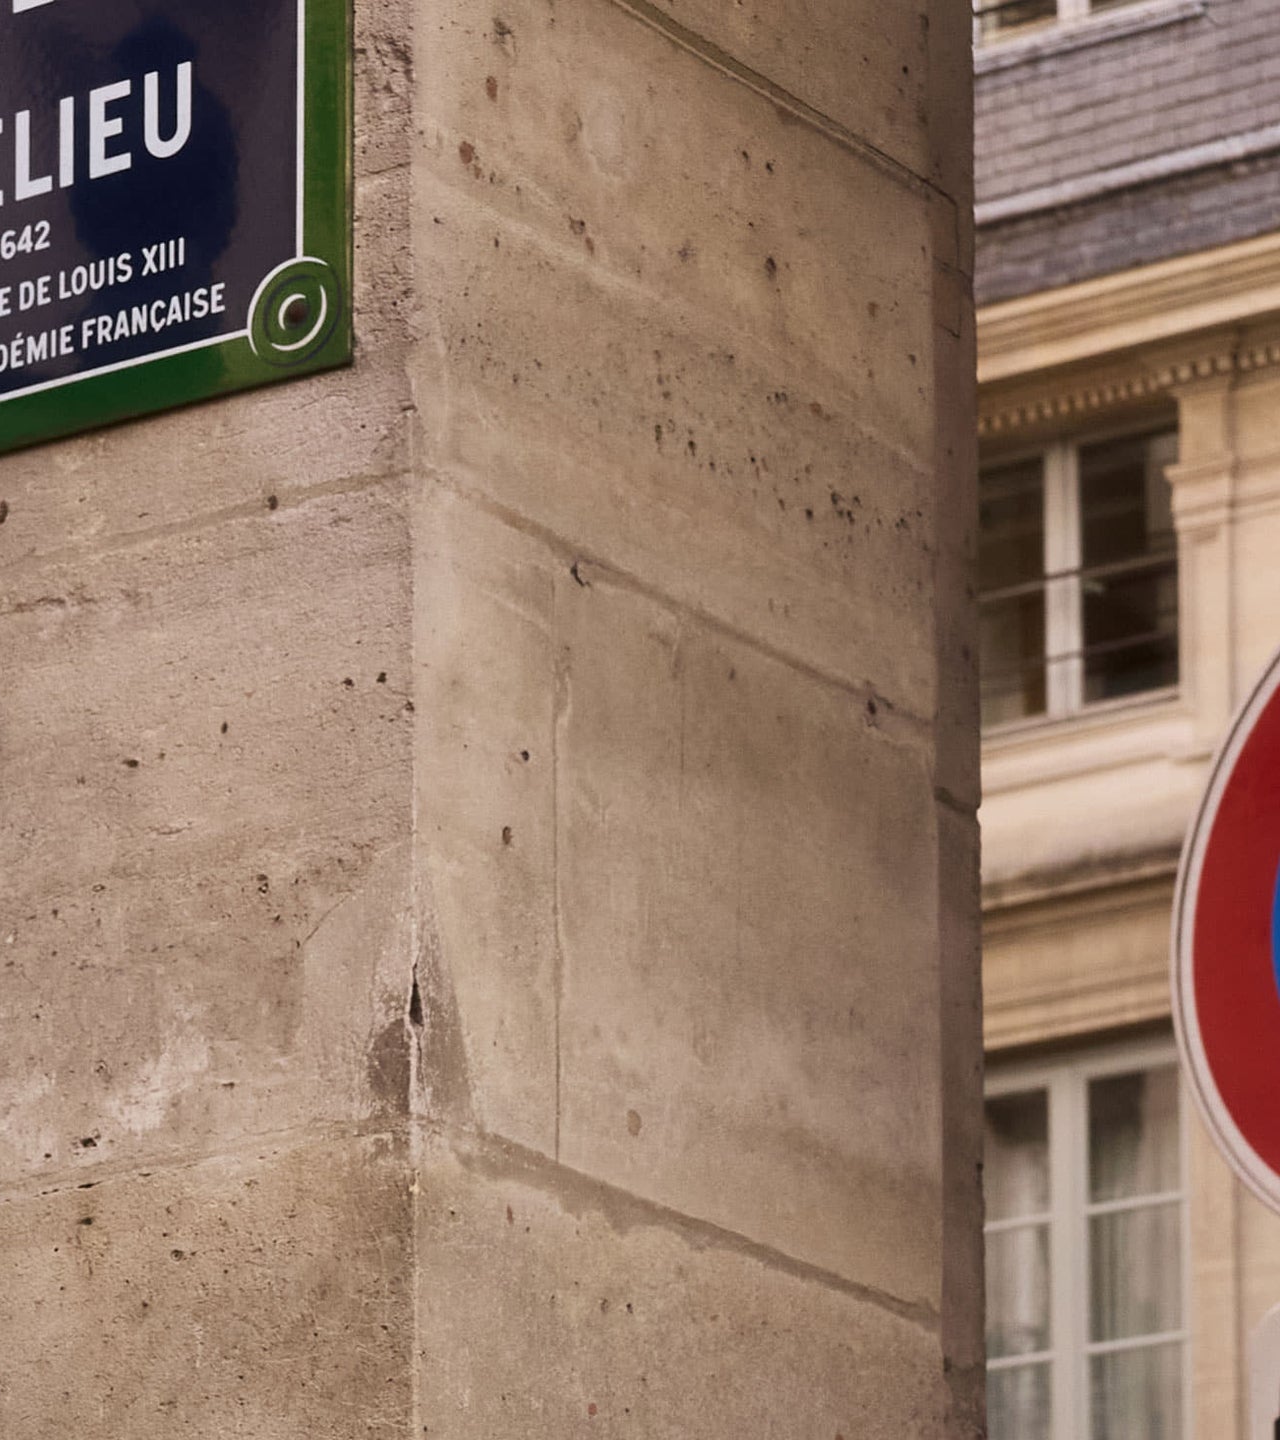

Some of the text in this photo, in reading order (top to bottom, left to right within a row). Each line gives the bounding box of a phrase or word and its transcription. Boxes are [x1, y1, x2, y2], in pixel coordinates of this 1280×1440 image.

[18, 274, 52, 312] DE
[58, 252, 133, 300] LOUIS
[141, 236, 185, 277] XIII
[81, 282, 226, 349] FRANÇAISE
